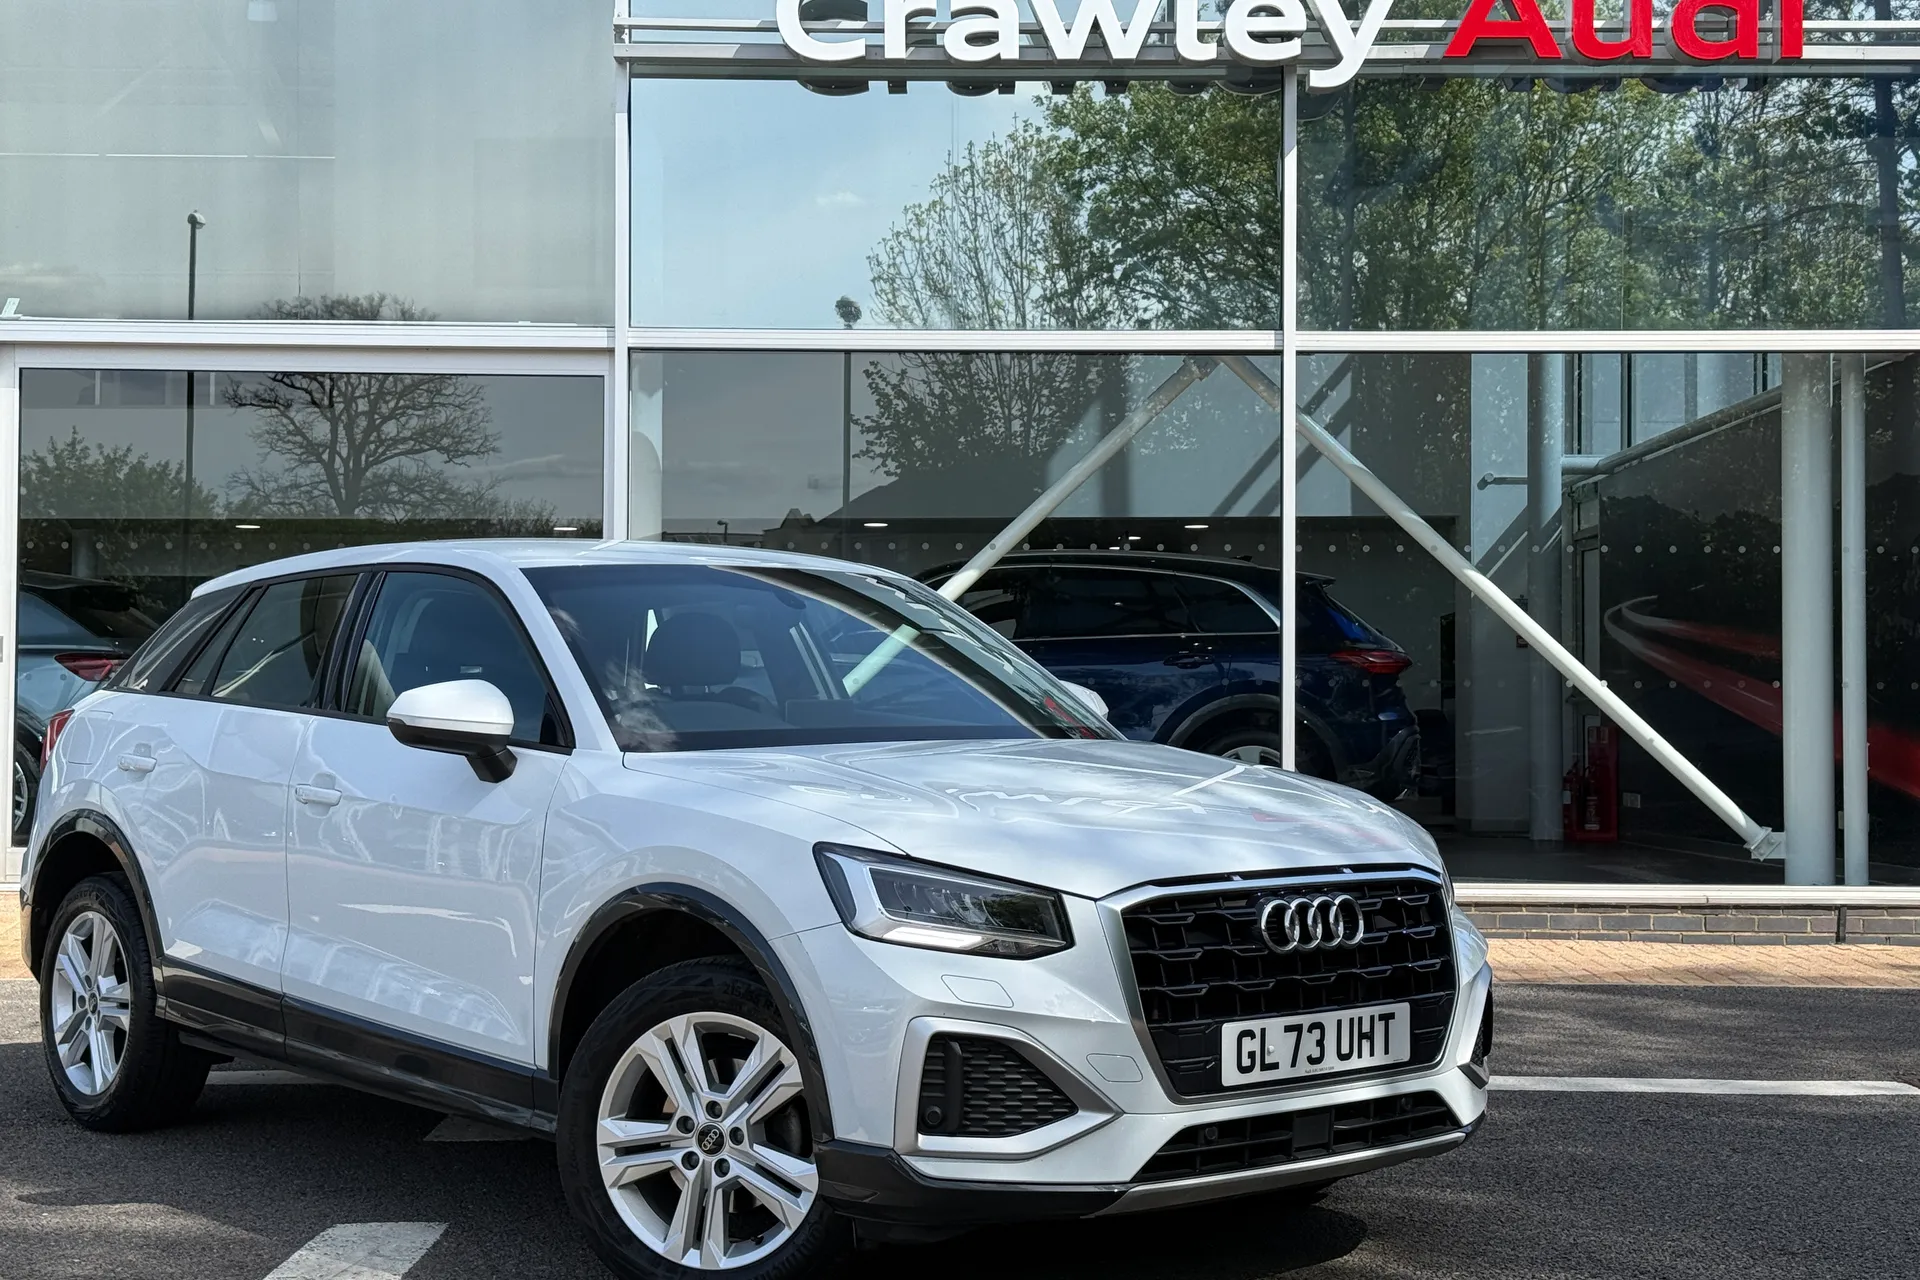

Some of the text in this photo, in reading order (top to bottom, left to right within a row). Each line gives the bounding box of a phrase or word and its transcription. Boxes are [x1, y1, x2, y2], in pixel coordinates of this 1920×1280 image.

[776, 0, 1803, 89] Crawley Audi
[1236, 1012, 1396, 1074] GL73 UHT
